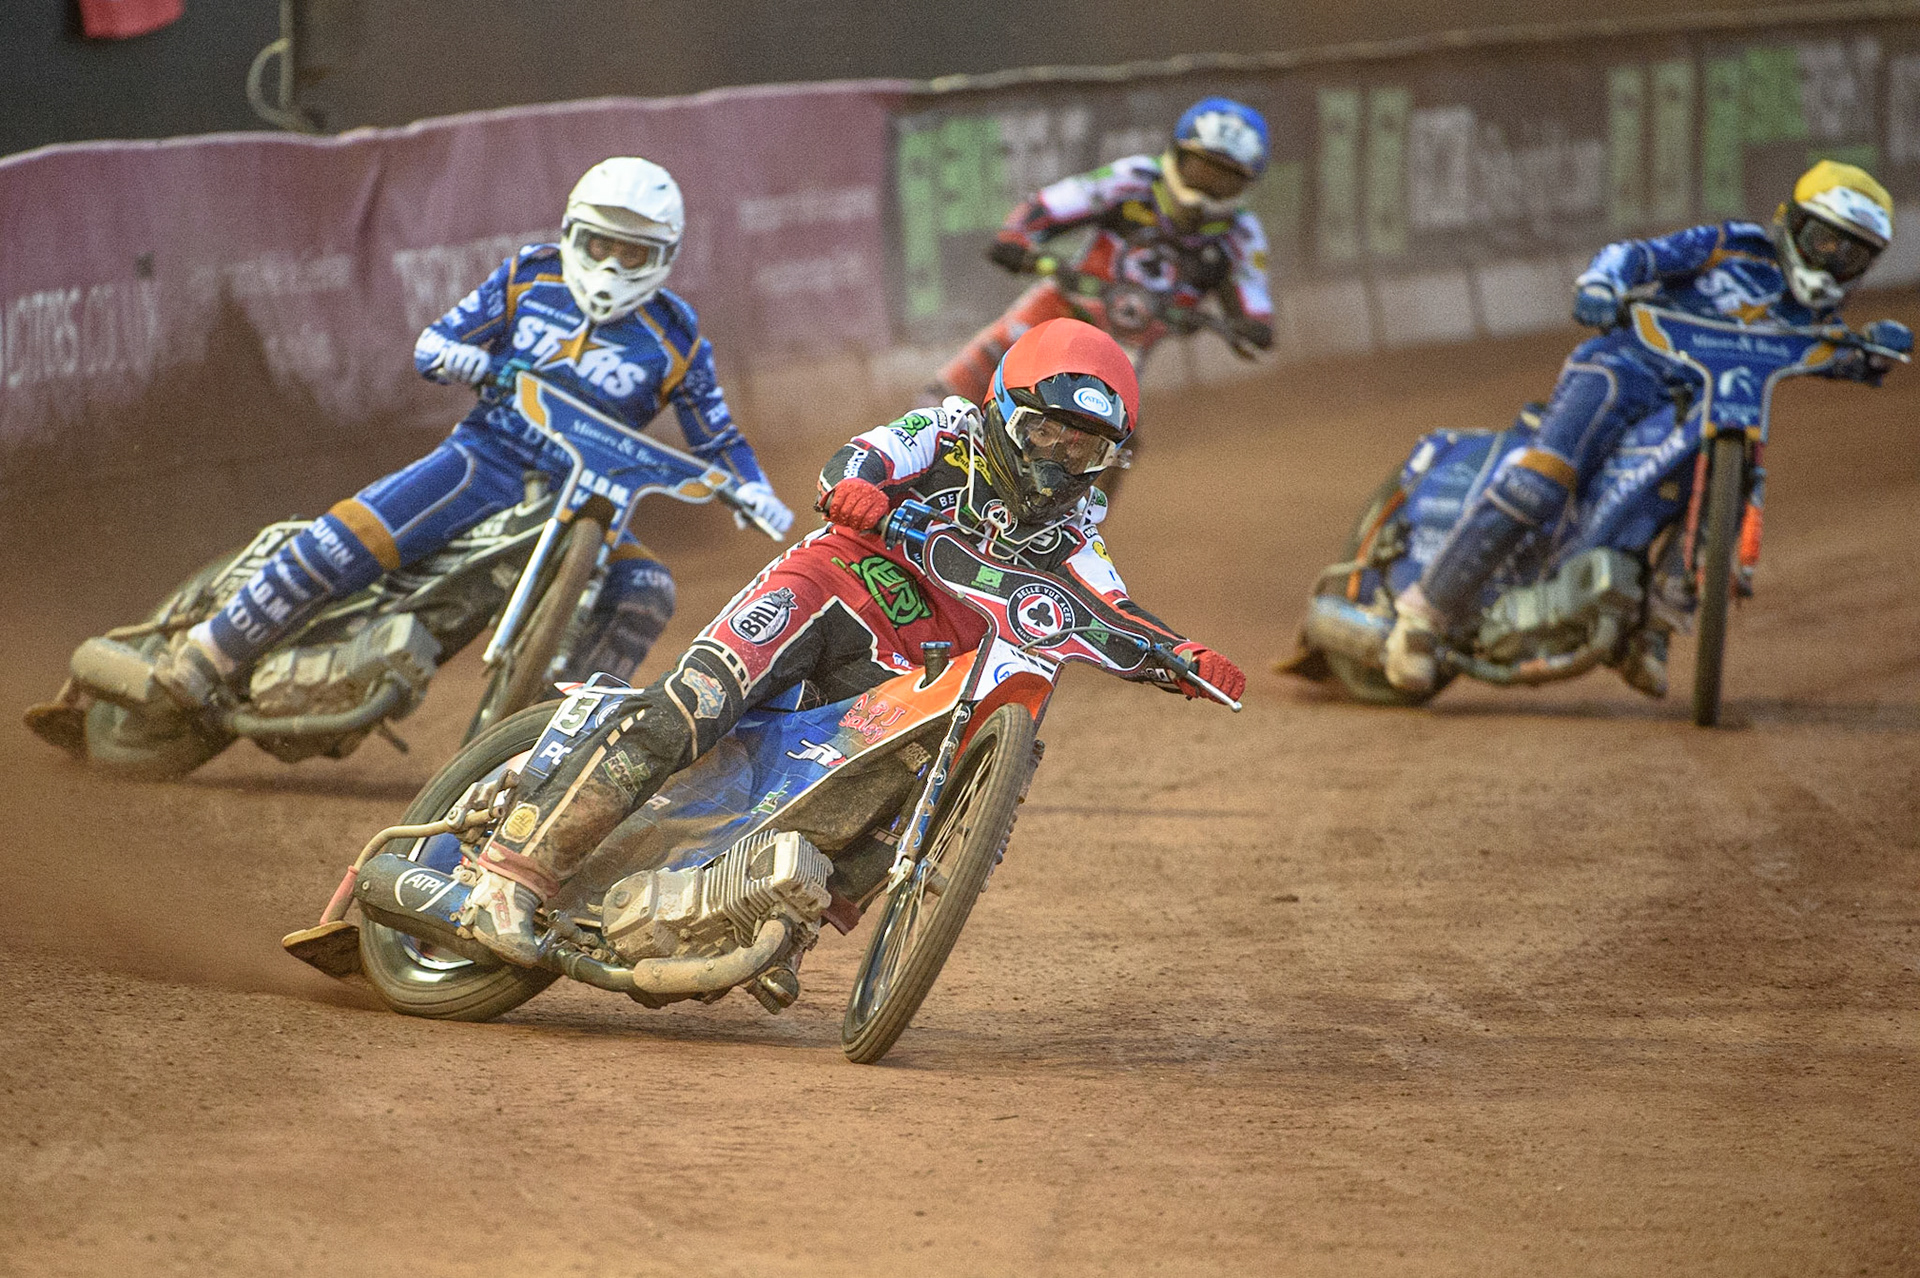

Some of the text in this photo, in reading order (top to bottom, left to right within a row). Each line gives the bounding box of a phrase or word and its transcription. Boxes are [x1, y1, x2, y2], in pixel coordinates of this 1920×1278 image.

[1016, 586, 1041, 600] BELLE
[1043, 587, 1060, 601] VUE
[1059, 602, 1072, 623] ACES
[559, 697, 599, 730] 5
[404, 873, 445, 895] ATPI
